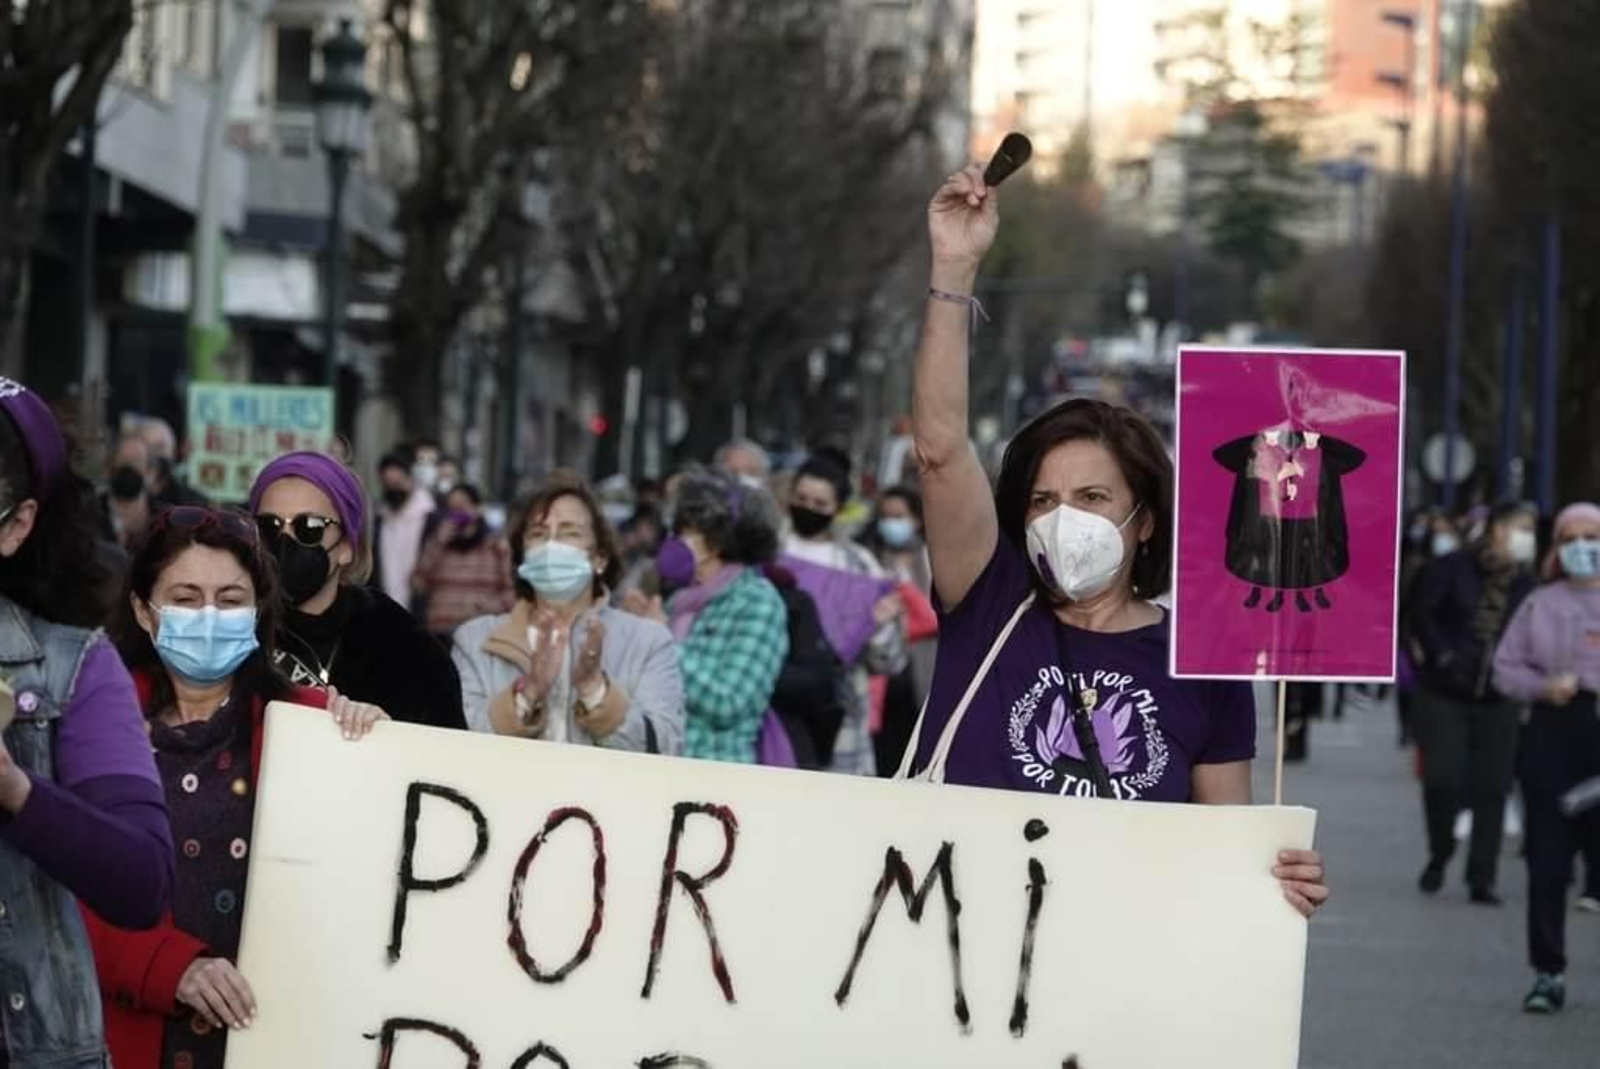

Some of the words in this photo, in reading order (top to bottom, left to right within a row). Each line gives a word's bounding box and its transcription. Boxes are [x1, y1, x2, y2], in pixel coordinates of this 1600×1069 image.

[1092, 669, 1134, 692] POR
[1011, 753, 1055, 789] POR
[385, 781, 738, 1004] POR
